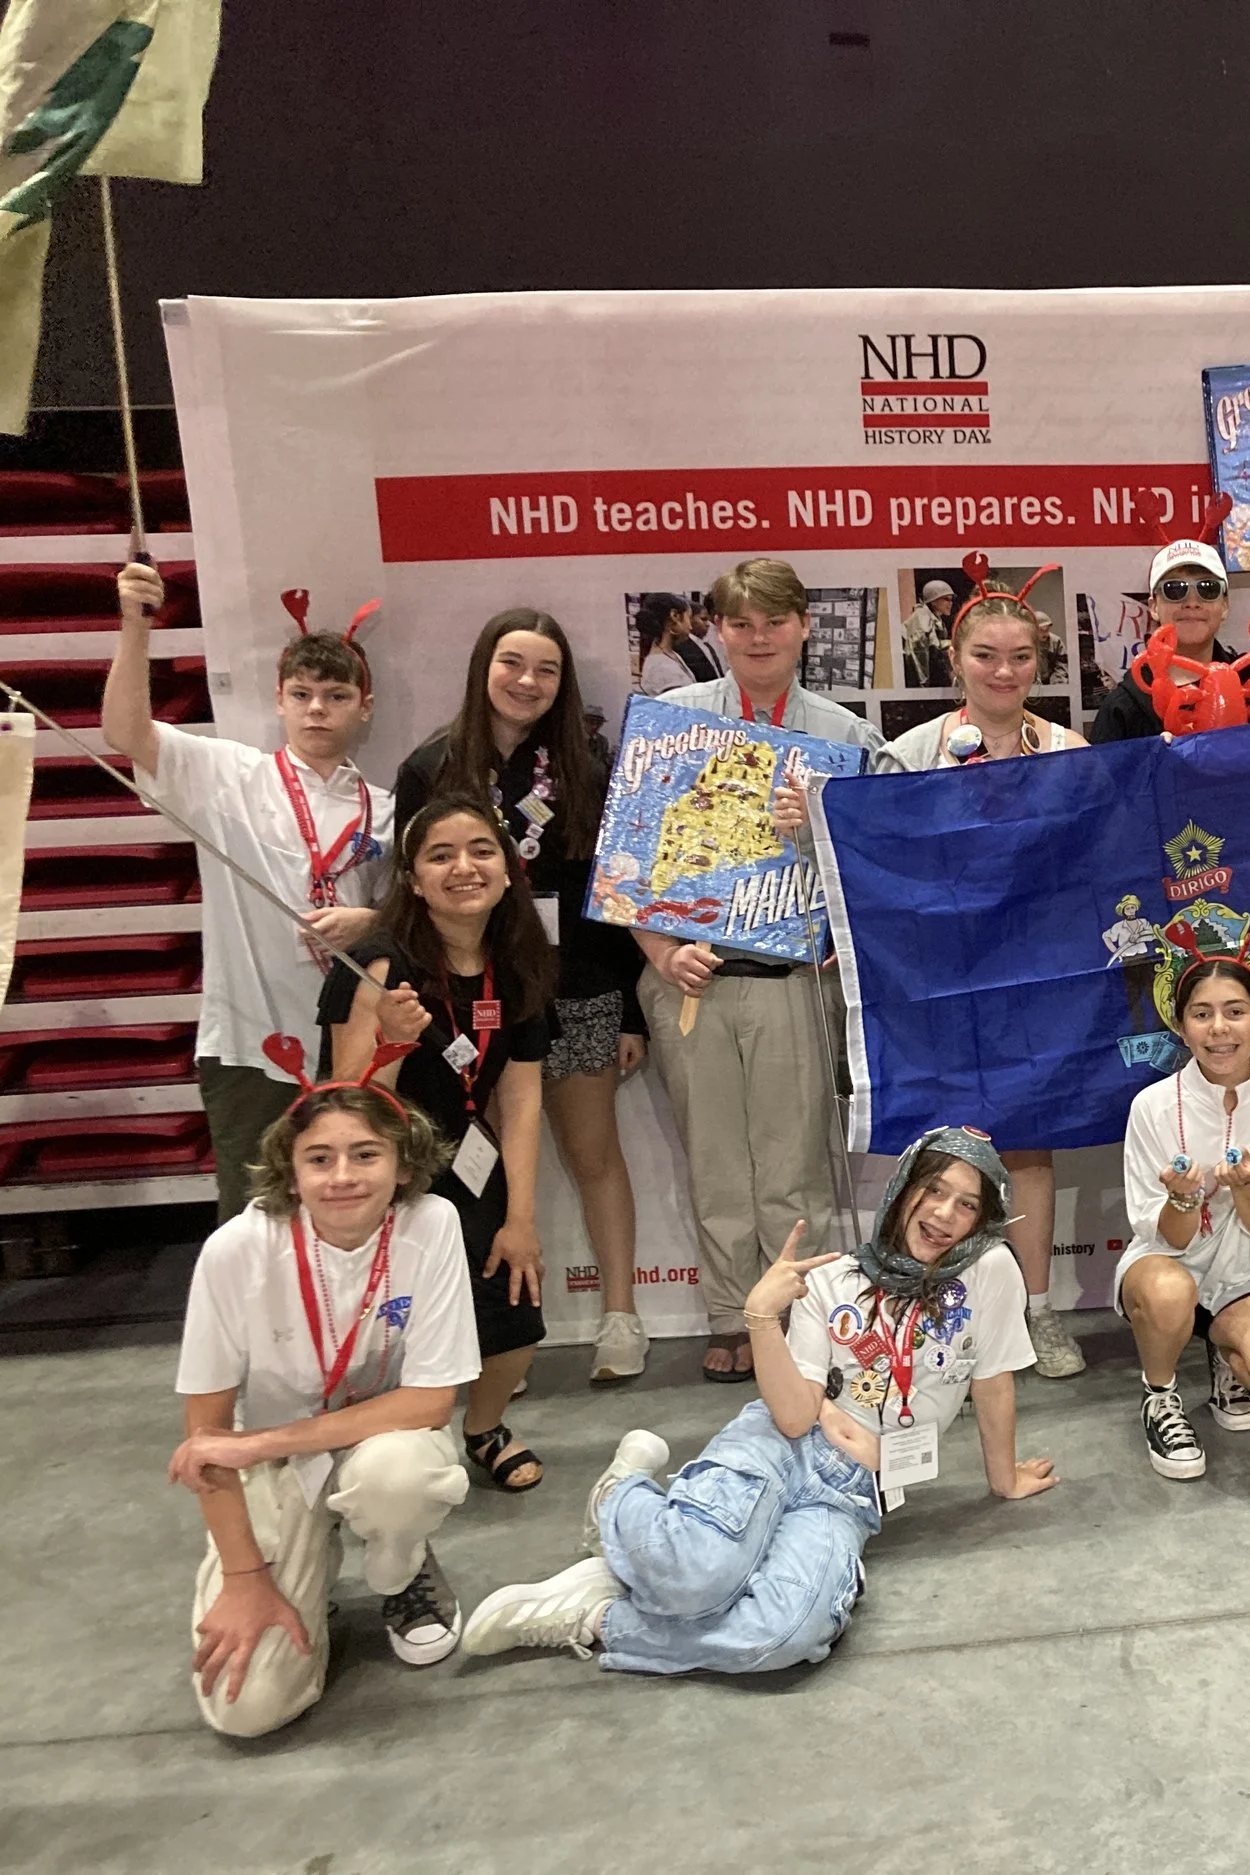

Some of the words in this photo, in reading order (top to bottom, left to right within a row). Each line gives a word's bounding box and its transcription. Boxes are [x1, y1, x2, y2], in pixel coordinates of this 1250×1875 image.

[858, 334, 987, 379] NHD
[862, 397, 989, 412] NATIONAL
[864, 430, 944, 444] HISTORY
[489, 496, 578, 535] NHD
[593, 492, 770, 532] teaches.
[787, 490, 873, 527] NHD
[890, 495, 1076, 535] prepares.
[623, 723, 747, 795] Greetings
[1169, 869, 1228, 898] DIRIGO
[1051, 1243, 1096, 1257] history
[565, 1265, 599, 1278] NHD
